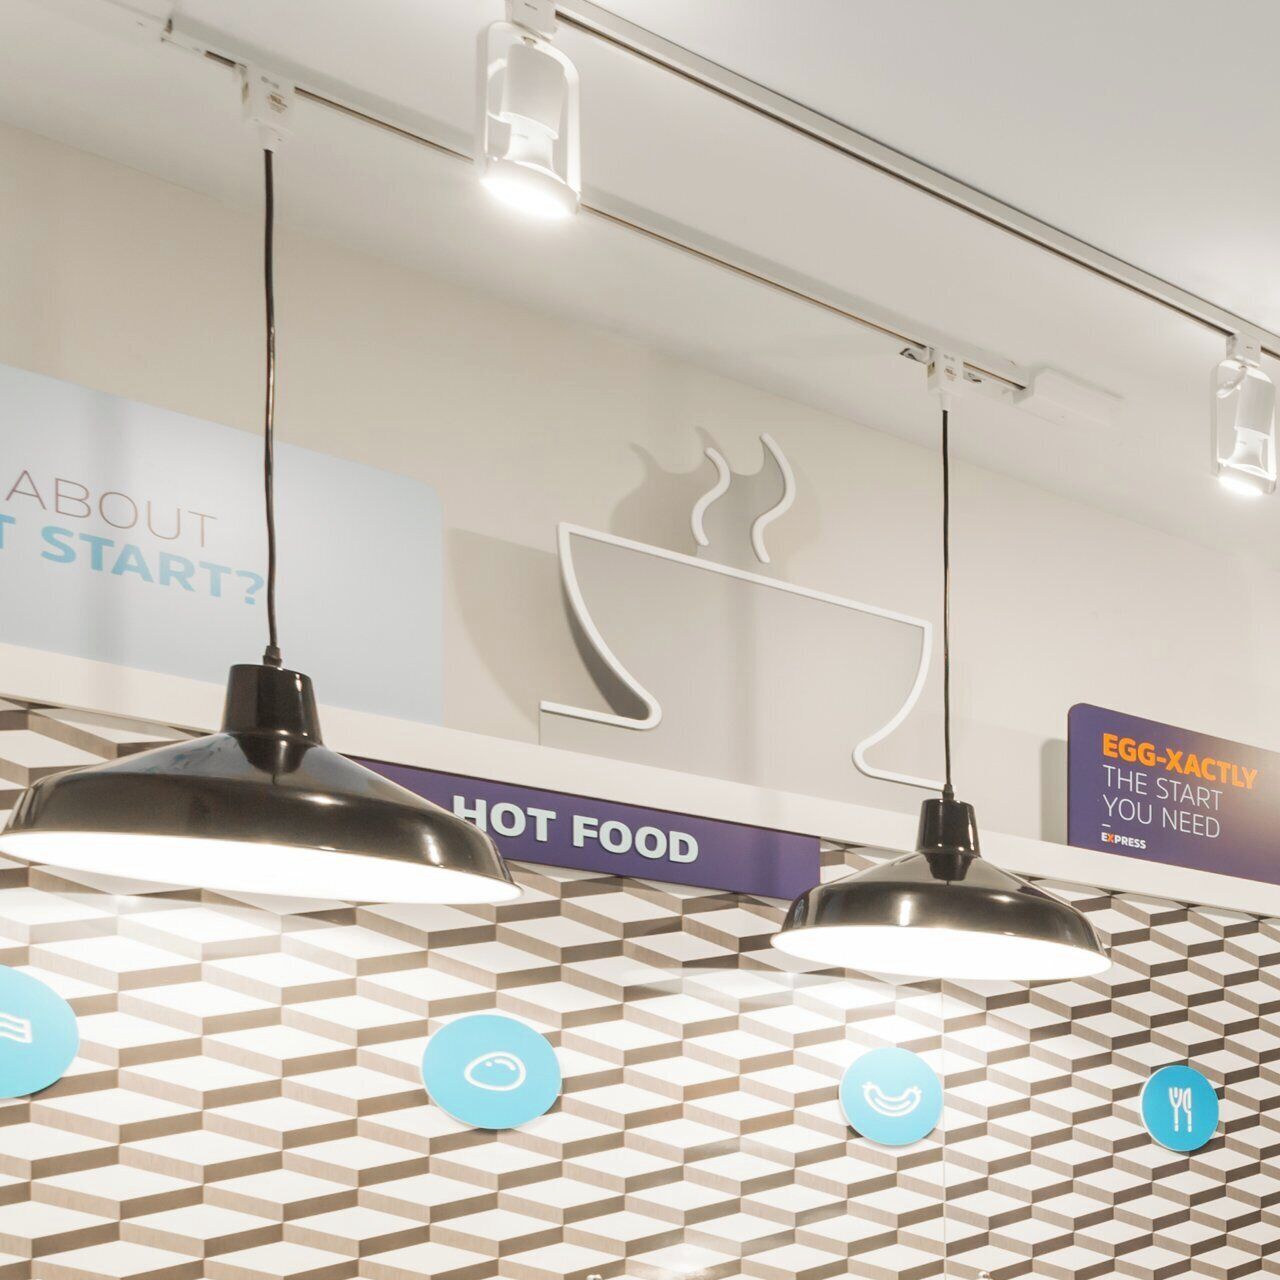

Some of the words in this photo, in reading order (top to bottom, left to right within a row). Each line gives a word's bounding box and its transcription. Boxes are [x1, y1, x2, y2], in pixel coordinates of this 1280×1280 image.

[5, 469, 217, 548] ABOUT
[40, 524, 266, 606] START?
[1102, 732, 1258, 789] EGG-XACTLY
[1102, 764, 1148, 796] THE
[1156, 777, 1223, 811] START
[453, 795, 556, 843] HOT
[572, 815, 699, 864] FOOD
[1101, 832, 1147, 850] EXPRESS
[1102, 794, 1153, 826] YOU
[1162, 807, 1220, 839] NEED
